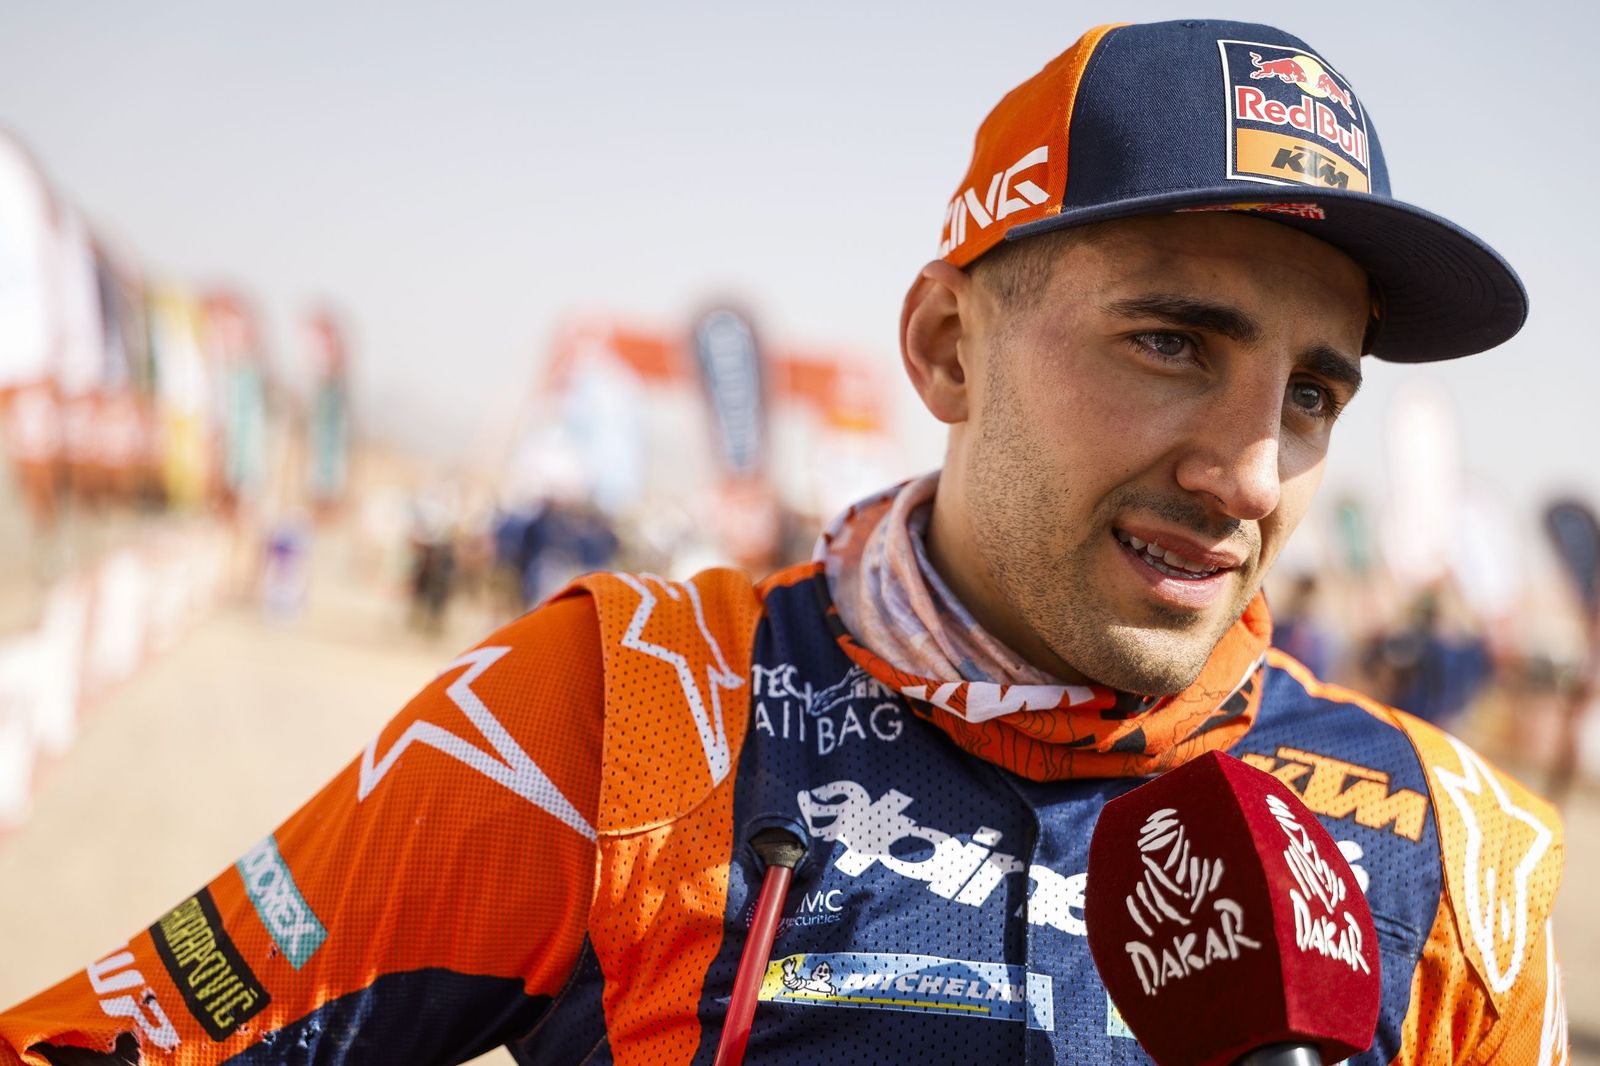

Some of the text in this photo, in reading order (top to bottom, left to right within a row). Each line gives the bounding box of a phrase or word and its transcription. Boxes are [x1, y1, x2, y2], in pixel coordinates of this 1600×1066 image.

[1235, 86, 1368, 168] Red Bull
[1271, 145, 1349, 189] KTM
[1241, 746, 1429, 843] KTM
[1125, 898, 1262, 996] DAKAR
[1288, 888, 1372, 976] DAKAR
[841, 973, 1024, 1005] MICHELIN
